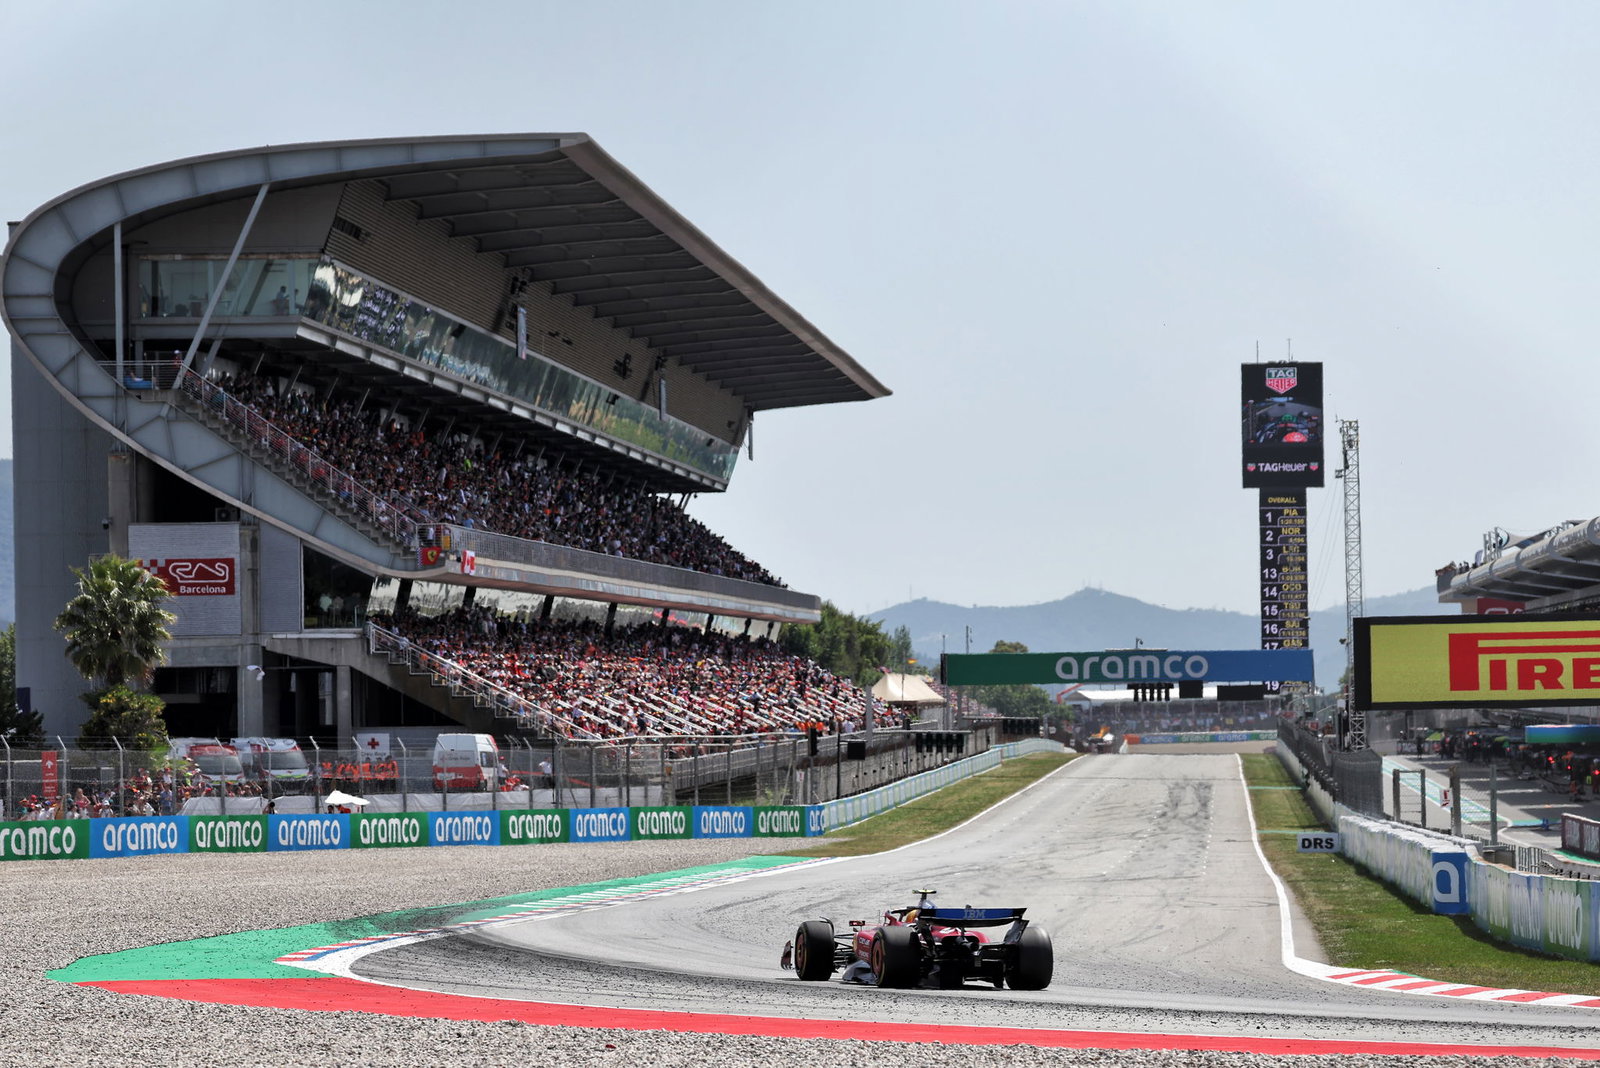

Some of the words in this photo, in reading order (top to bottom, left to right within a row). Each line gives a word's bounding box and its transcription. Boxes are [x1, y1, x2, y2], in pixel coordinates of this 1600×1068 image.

[1269, 369, 1294, 378] TAG
[1268, 379, 1295, 392] HEUER
[1265, 512, 1272, 523] 1
[1265, 530, 1274, 541] 2
[1266, 549, 1274, 560] 3
[1263, 568, 1277, 579] 13
[179, 585, 226, 594] Barcelona
[1263, 586, 1278, 597] 14
[1263, 605, 1278, 616] 15
[1264, 624, 1278, 634] 16
[1055, 655, 1209, 680] aramco
[1264, 681, 1280, 691] 19
[1218, 733, 1248, 741] aramco
[508, 814, 561, 840] aramco
[575, 812, 626, 838] aramco
[637, 811, 686, 835] aramco
[701, 811, 745, 834] aramco
[758, 810, 800, 833] aramco
[195, 820, 263, 848] aramco
[278, 819, 341, 846] aramco
[360, 817, 419, 844] aramco
[435, 816, 491, 842] aramco
[103, 822, 178, 851] aramco
[1301, 837, 1334, 850] DRS
[963, 909, 986, 919] IBM
